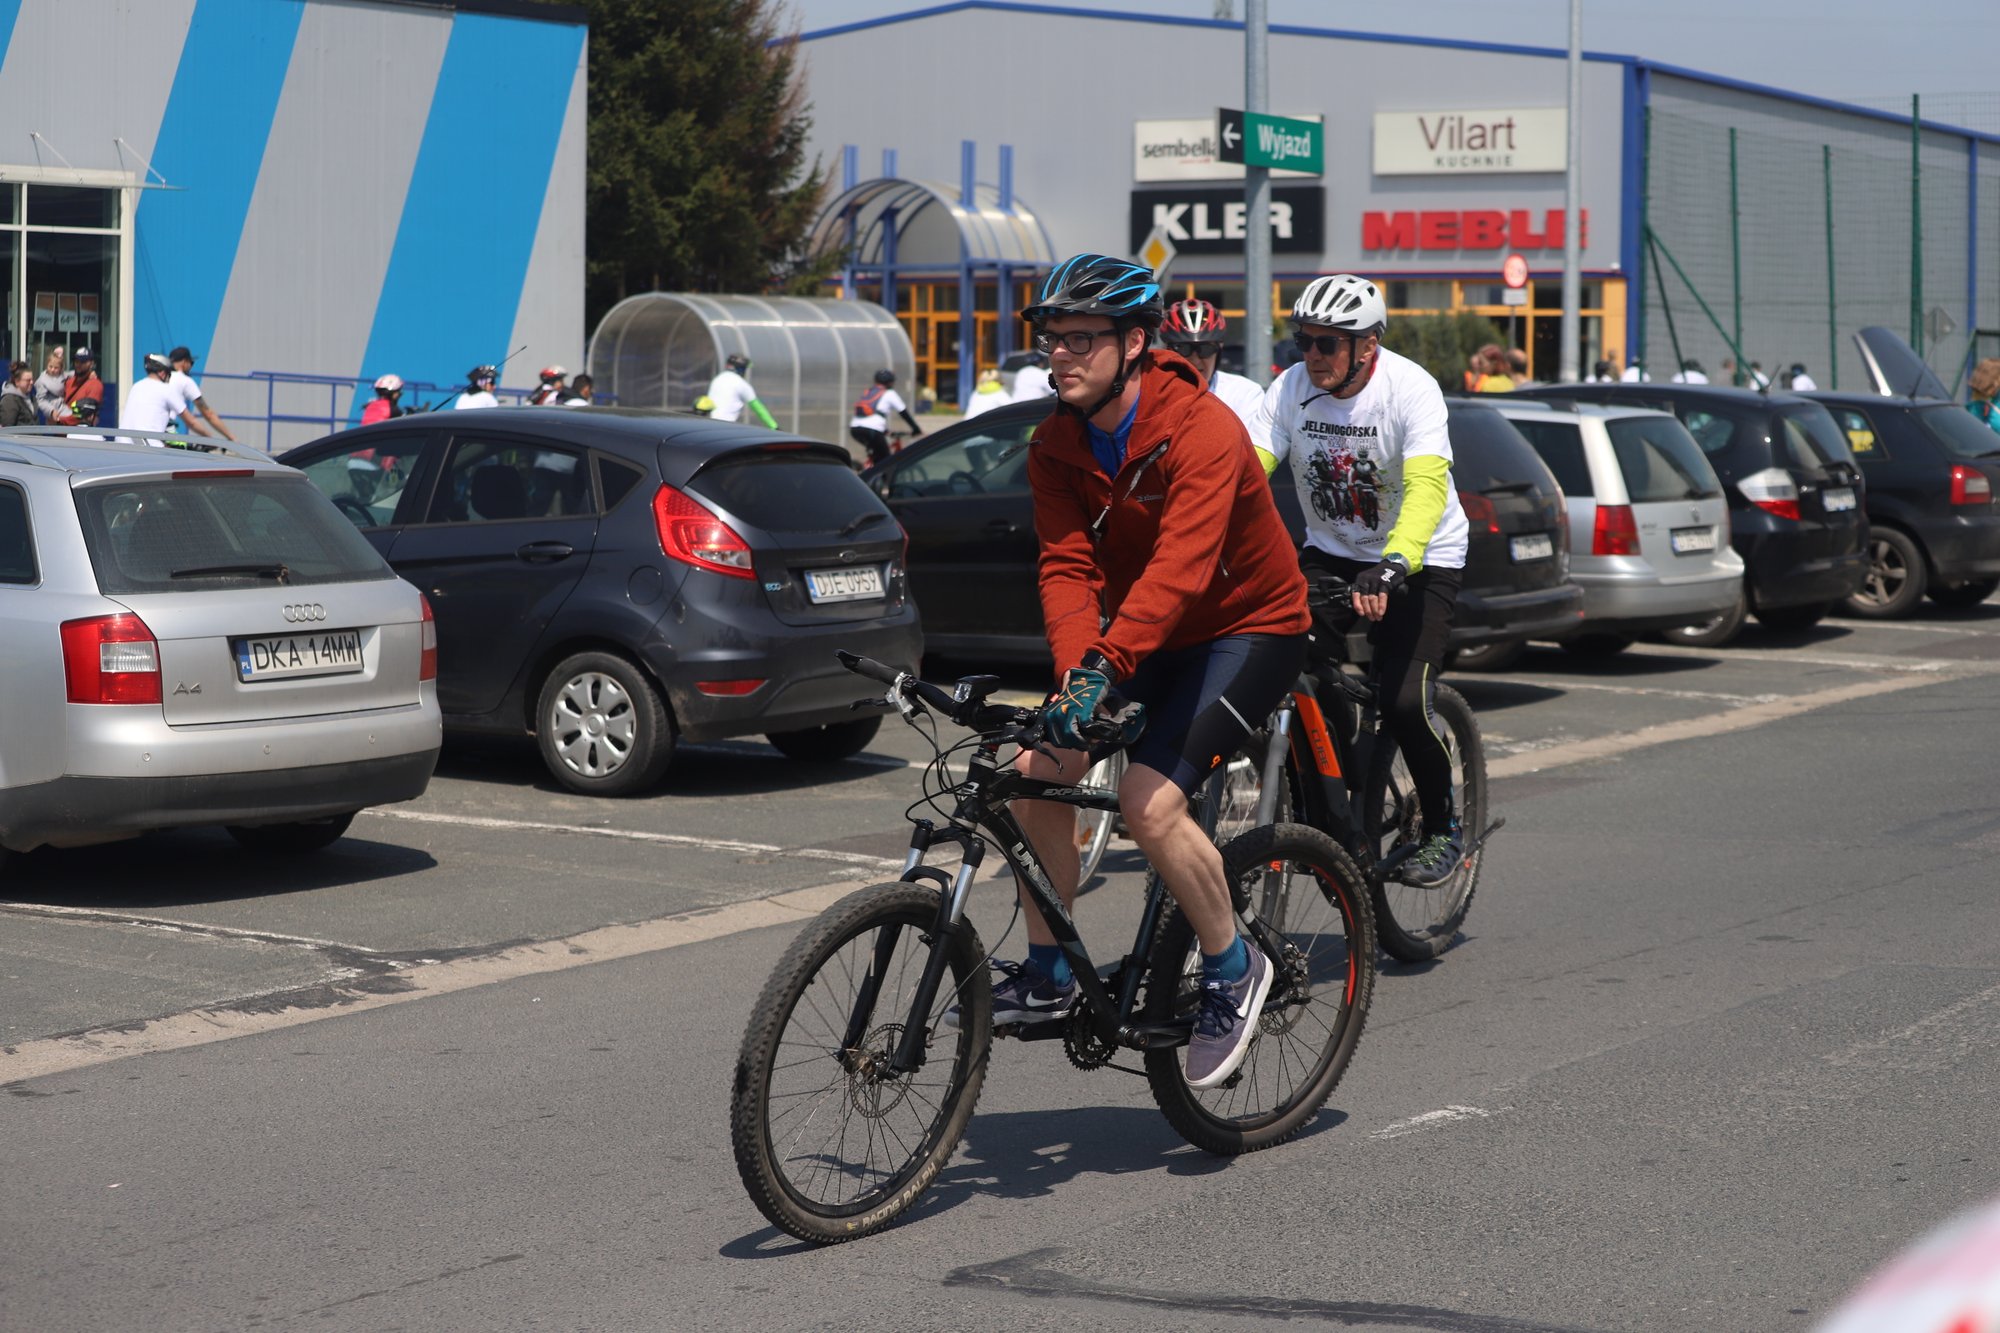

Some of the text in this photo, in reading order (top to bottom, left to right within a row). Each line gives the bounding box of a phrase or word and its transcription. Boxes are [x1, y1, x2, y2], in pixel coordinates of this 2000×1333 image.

[1257, 123, 1312, 161] Wyjazd
[1417, 115, 1516, 151] Vilart
[1435, 155, 1514, 168] KUCHNIE
[1153, 202, 1294, 241] KLER
[1362, 208, 1589, 251] MEBLE
[1302, 420, 1378, 437] JELENIOGÓRSKA
[815, 572, 844, 596] DJE
[252, 633, 358, 671] DKA 14MW
[172, 679, 202, 696] A4
[862, 1161, 937, 1228] RACING RALPH
